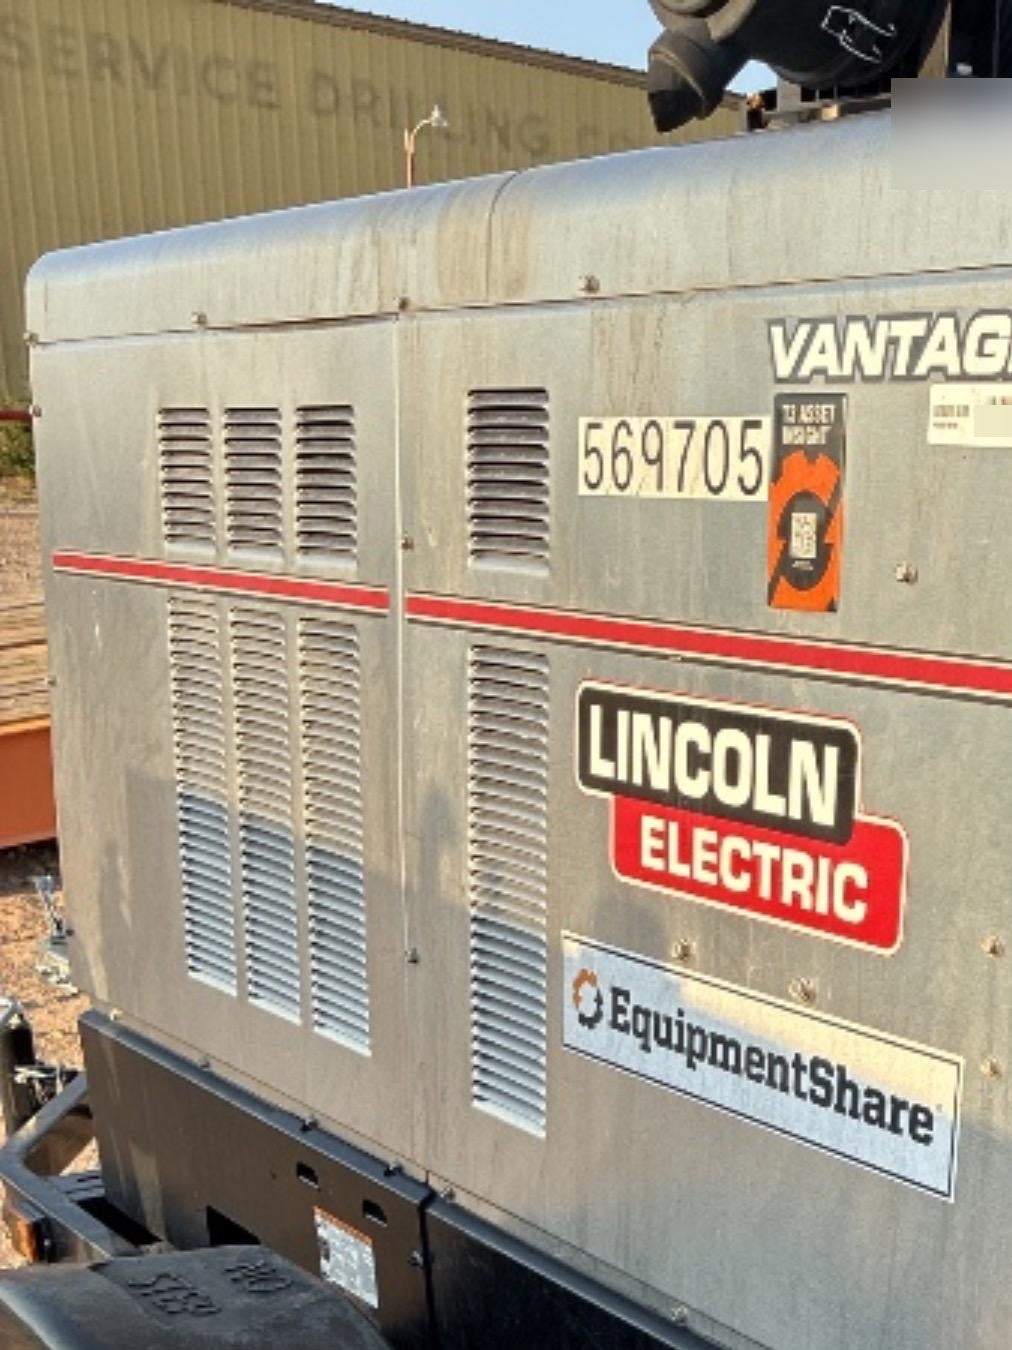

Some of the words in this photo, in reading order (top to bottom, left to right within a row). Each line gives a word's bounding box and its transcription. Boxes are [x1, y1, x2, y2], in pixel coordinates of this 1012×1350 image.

[0, 13, 280, 110] SERVICE
[584, 418, 764, 496] 569705
[588, 703, 840, 828] LINCOLN
[640, 814, 869, 924] ELECTRIC
[609, 986, 935, 1146] EquipmentShare
